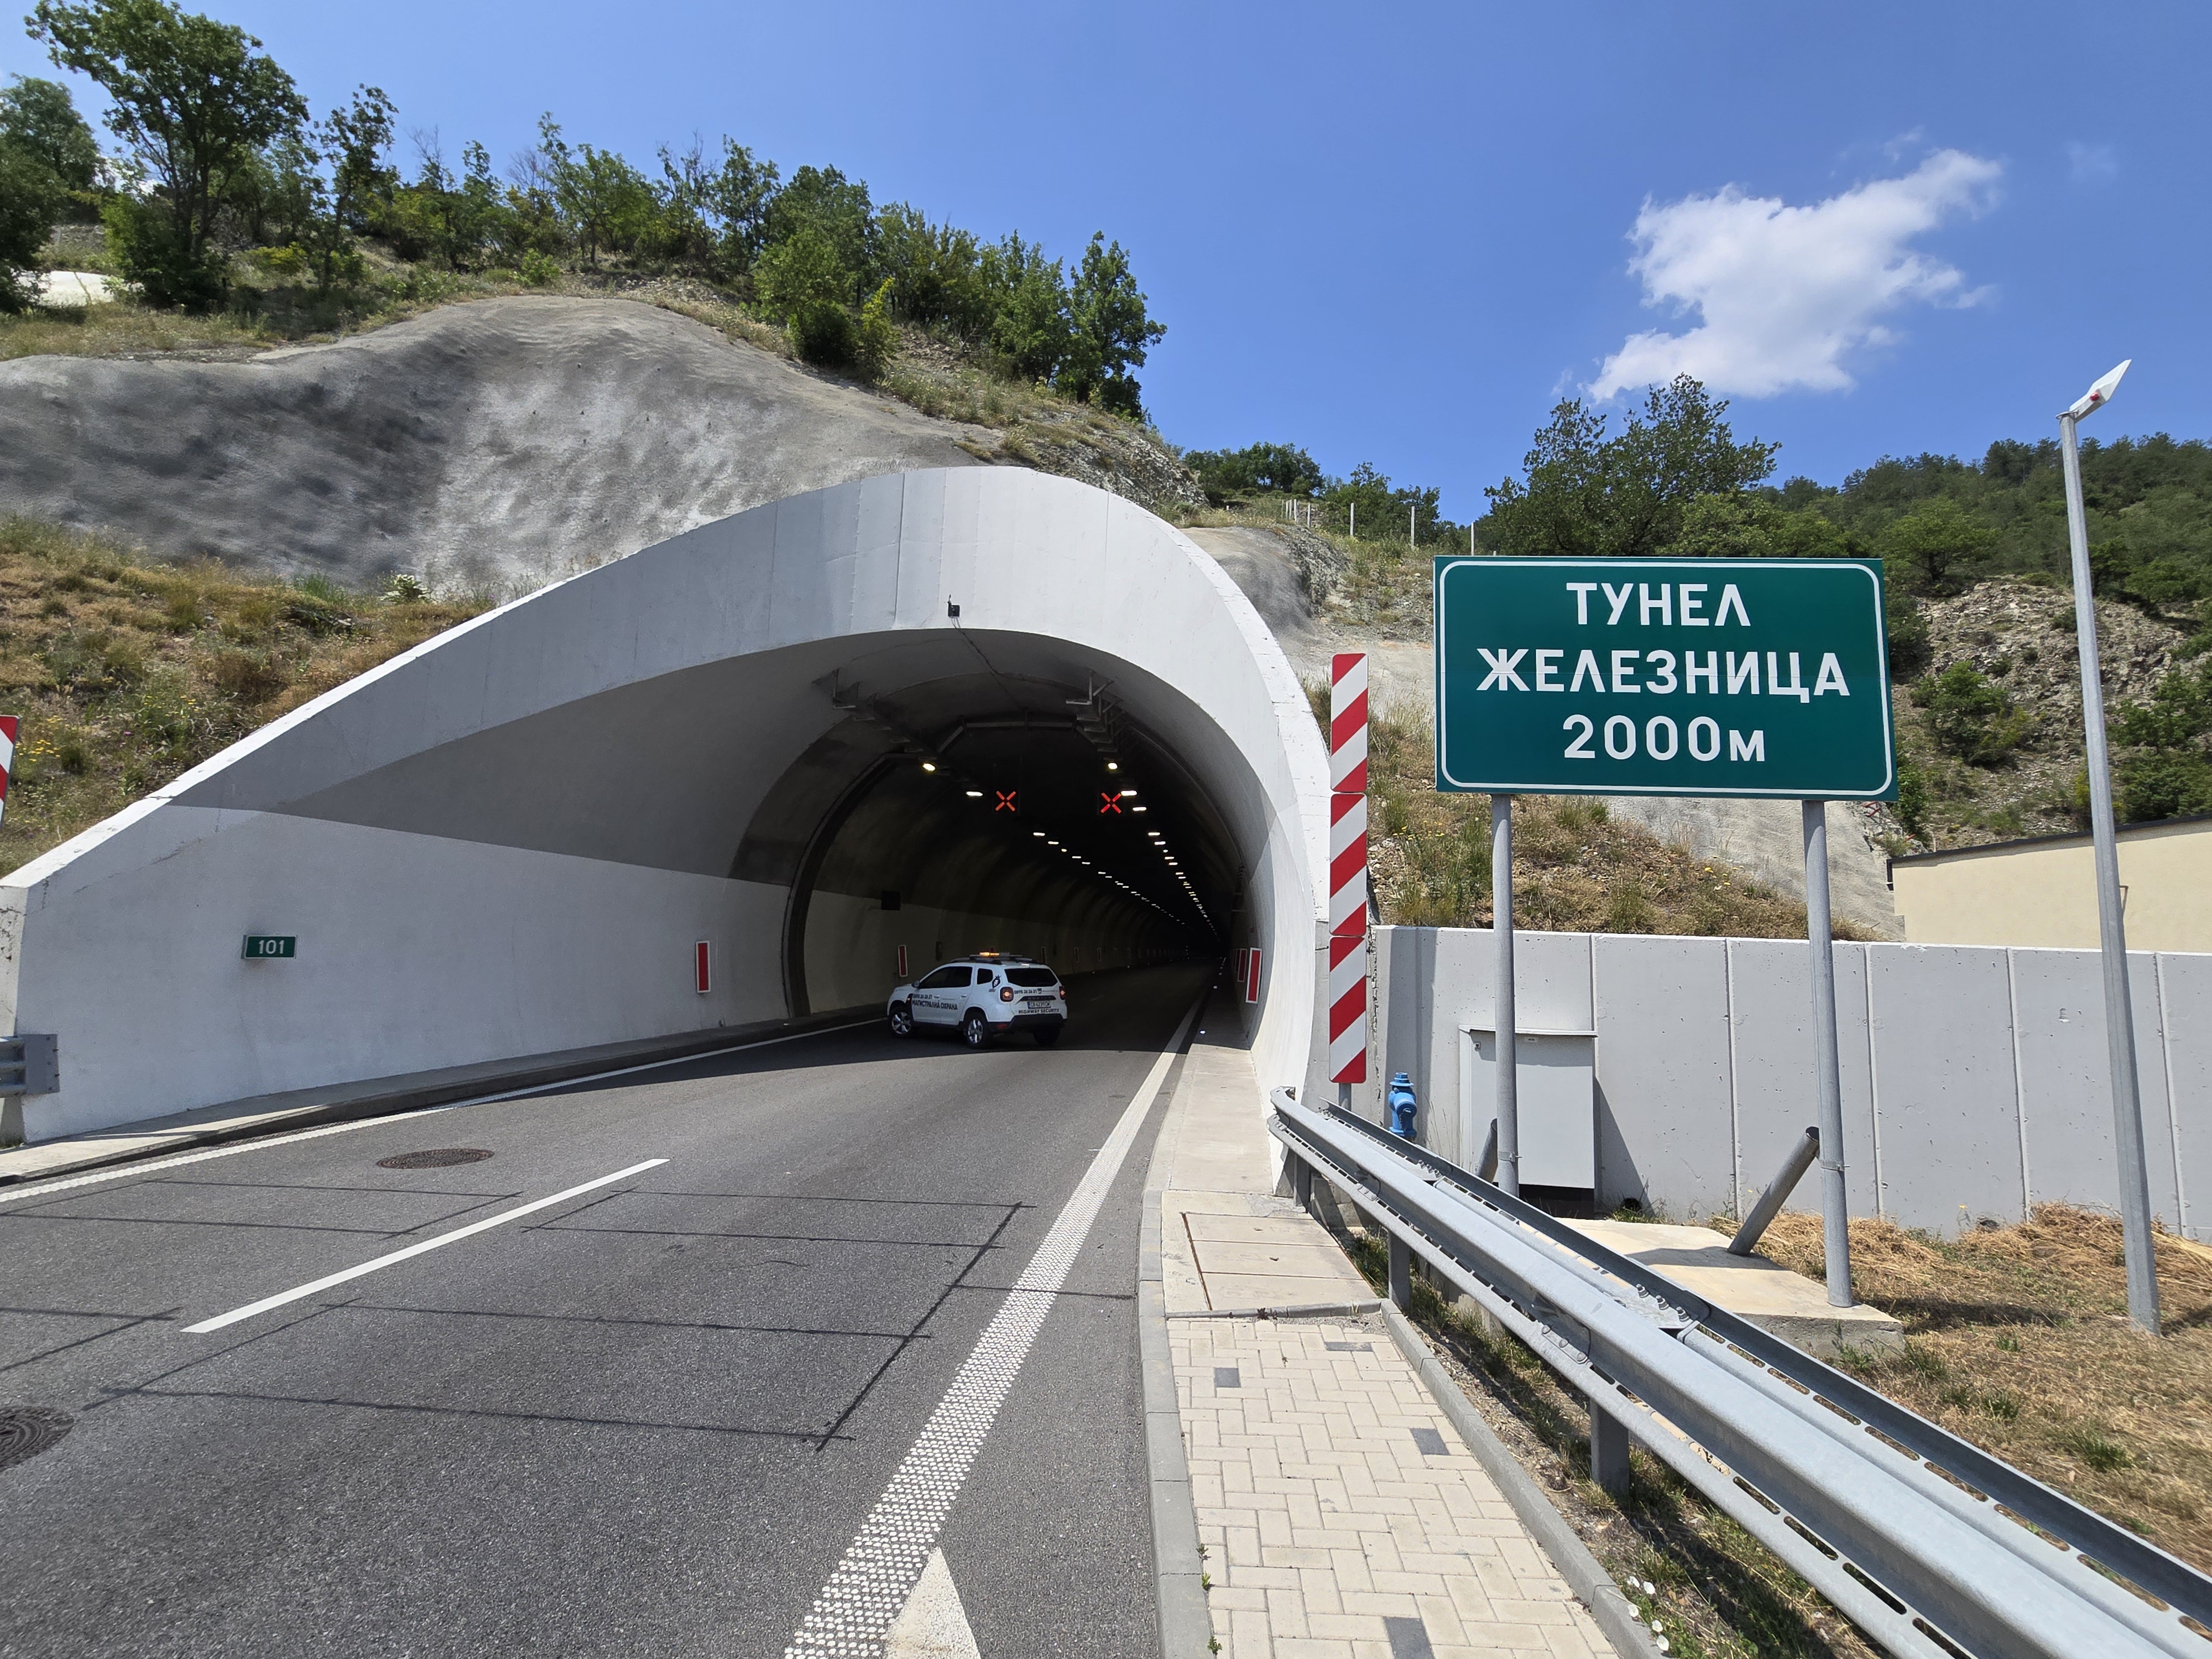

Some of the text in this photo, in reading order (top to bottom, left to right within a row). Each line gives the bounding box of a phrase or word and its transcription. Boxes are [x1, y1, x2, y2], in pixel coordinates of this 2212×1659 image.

[1566, 582, 1751, 627] ТУНЕЛ
[1476, 648, 1850, 703] ЖЕЛЕЗНИЦА
[259, 940, 284, 954] 101
